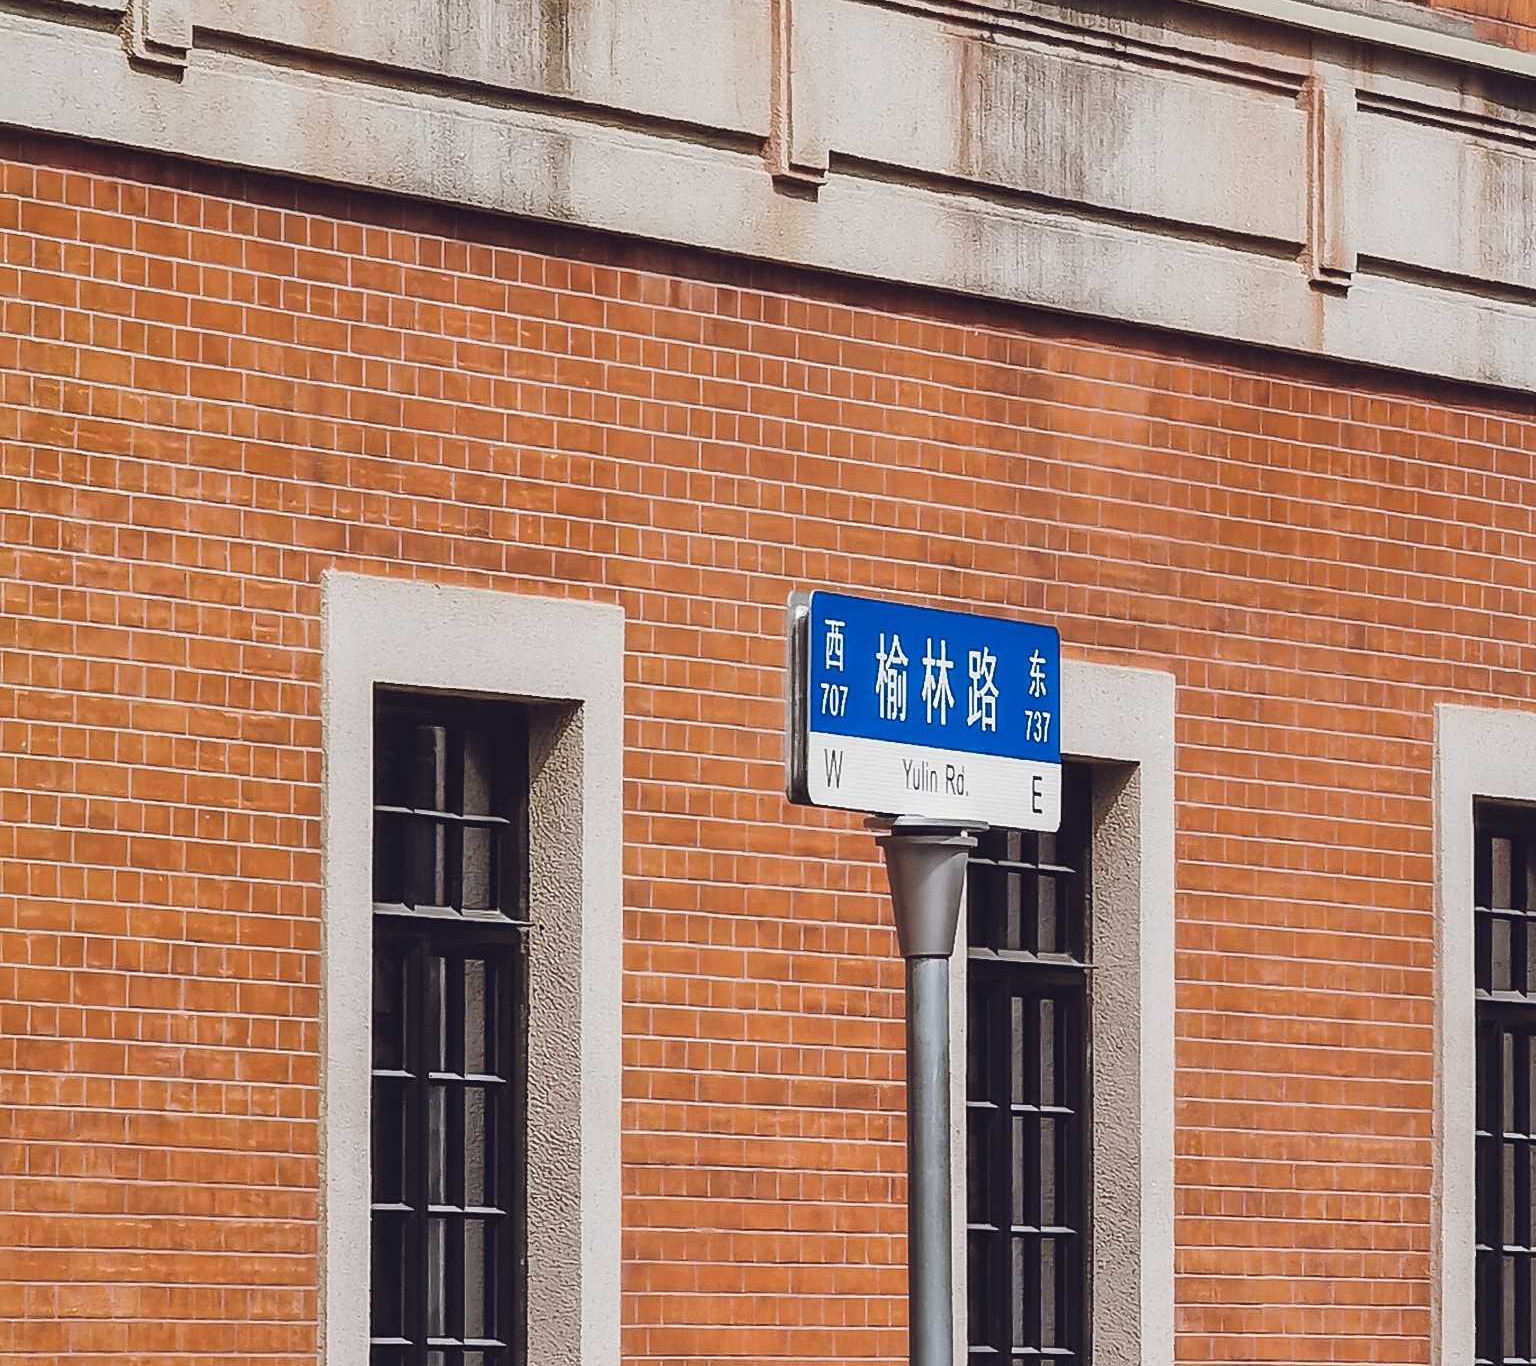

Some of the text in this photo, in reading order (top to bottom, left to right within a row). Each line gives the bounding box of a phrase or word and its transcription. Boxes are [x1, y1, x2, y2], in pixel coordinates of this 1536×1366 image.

[824, 619, 846, 672] 西
[875, 633, 1000, 733] 榆林路
[1028, 649, 1047, 698] 东
[820, 682, 849, 717] 707
[1024, 710, 1051, 743] 737
[824, 748, 844, 789] W
[902, 758, 969, 797] Yulin Rd.
[1031, 775, 1043, 814] E
